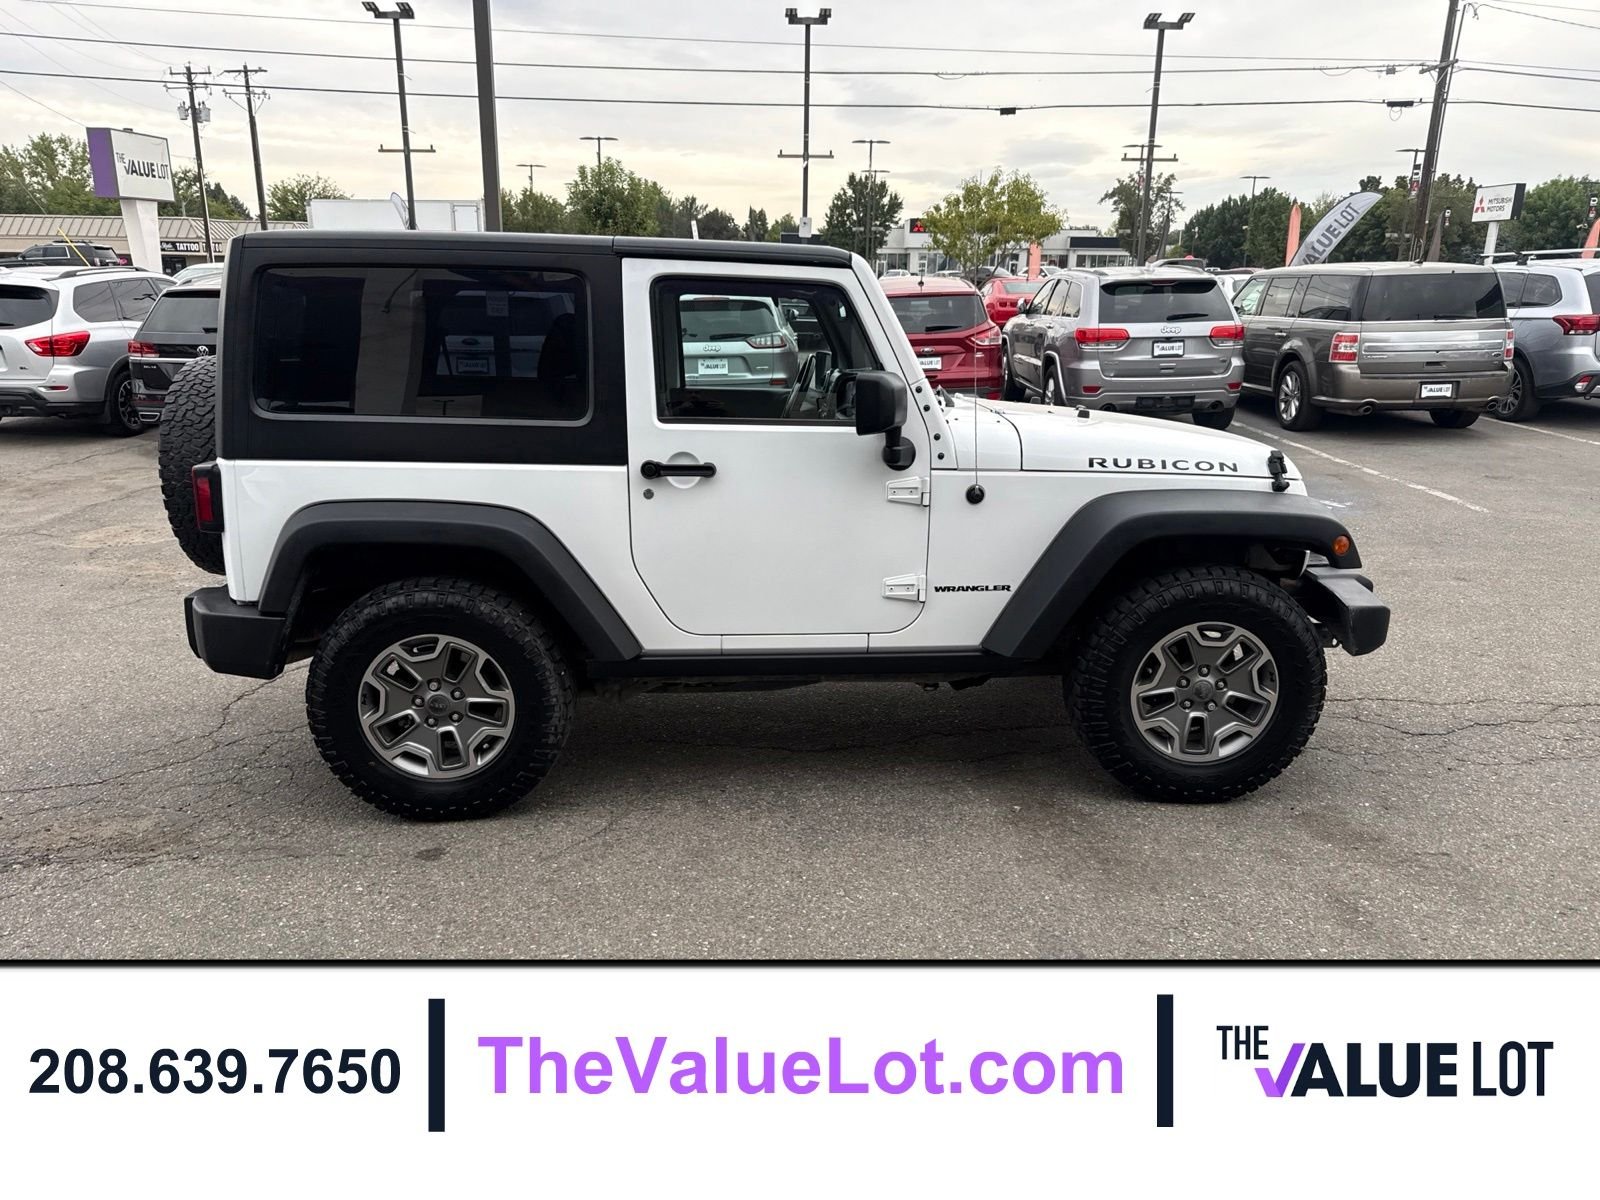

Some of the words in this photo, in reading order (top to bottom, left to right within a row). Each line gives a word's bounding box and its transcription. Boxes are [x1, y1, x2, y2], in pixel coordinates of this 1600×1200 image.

[115, 152, 126, 164] THE
[124, 159, 156, 178] VALUE
[156, 163, 169, 180] LOT
[1334, 202, 1360, 229] LOT
[176, 242, 199, 251] TATTOO
[1161, 326, 1182, 335] Jeep
[703, 344, 721, 353] Jeep
[1088, 457, 1238, 472] RUBICON
[934, 585, 1012, 593] WRANGLER
